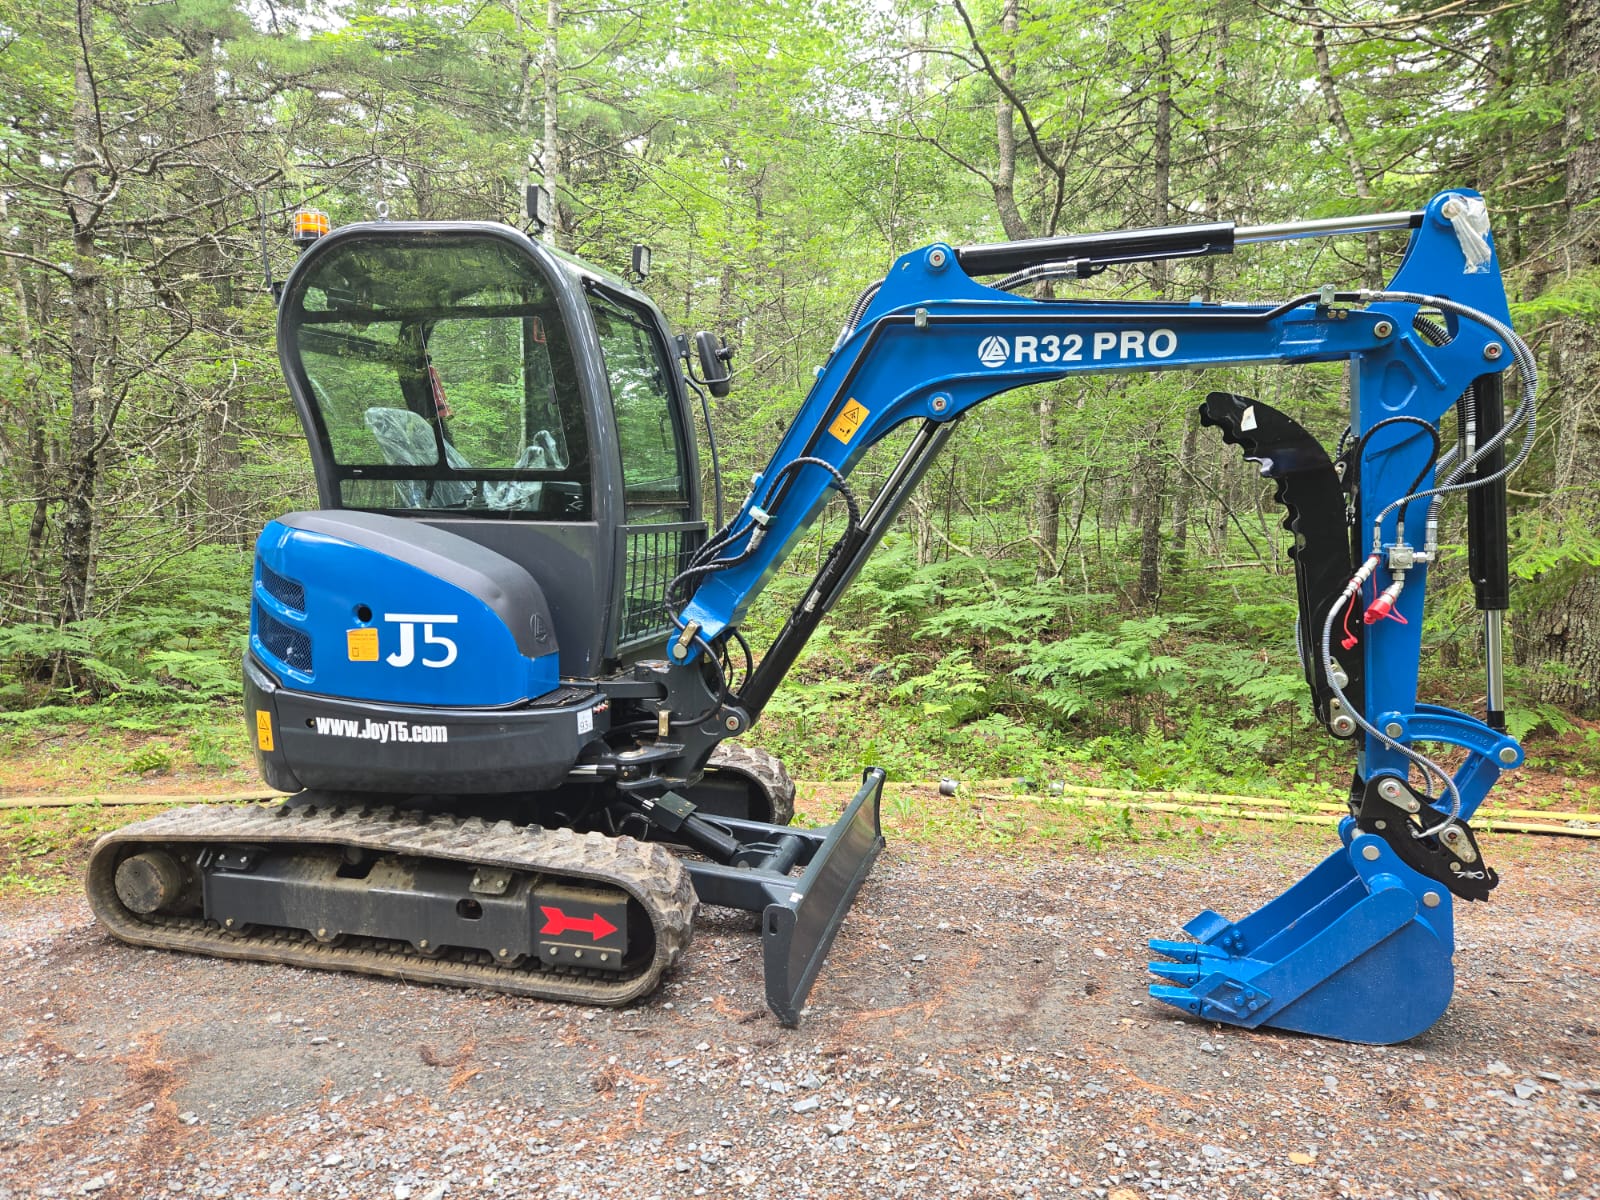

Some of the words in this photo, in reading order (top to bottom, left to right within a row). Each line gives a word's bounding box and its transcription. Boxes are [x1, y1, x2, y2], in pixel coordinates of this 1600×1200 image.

[1014, 334, 1083, 363] R32
[1093, 328, 1178, 360] PRO
[384, 613, 458, 668] J5
[315, 716, 448, 744] www.JoyT5.com
